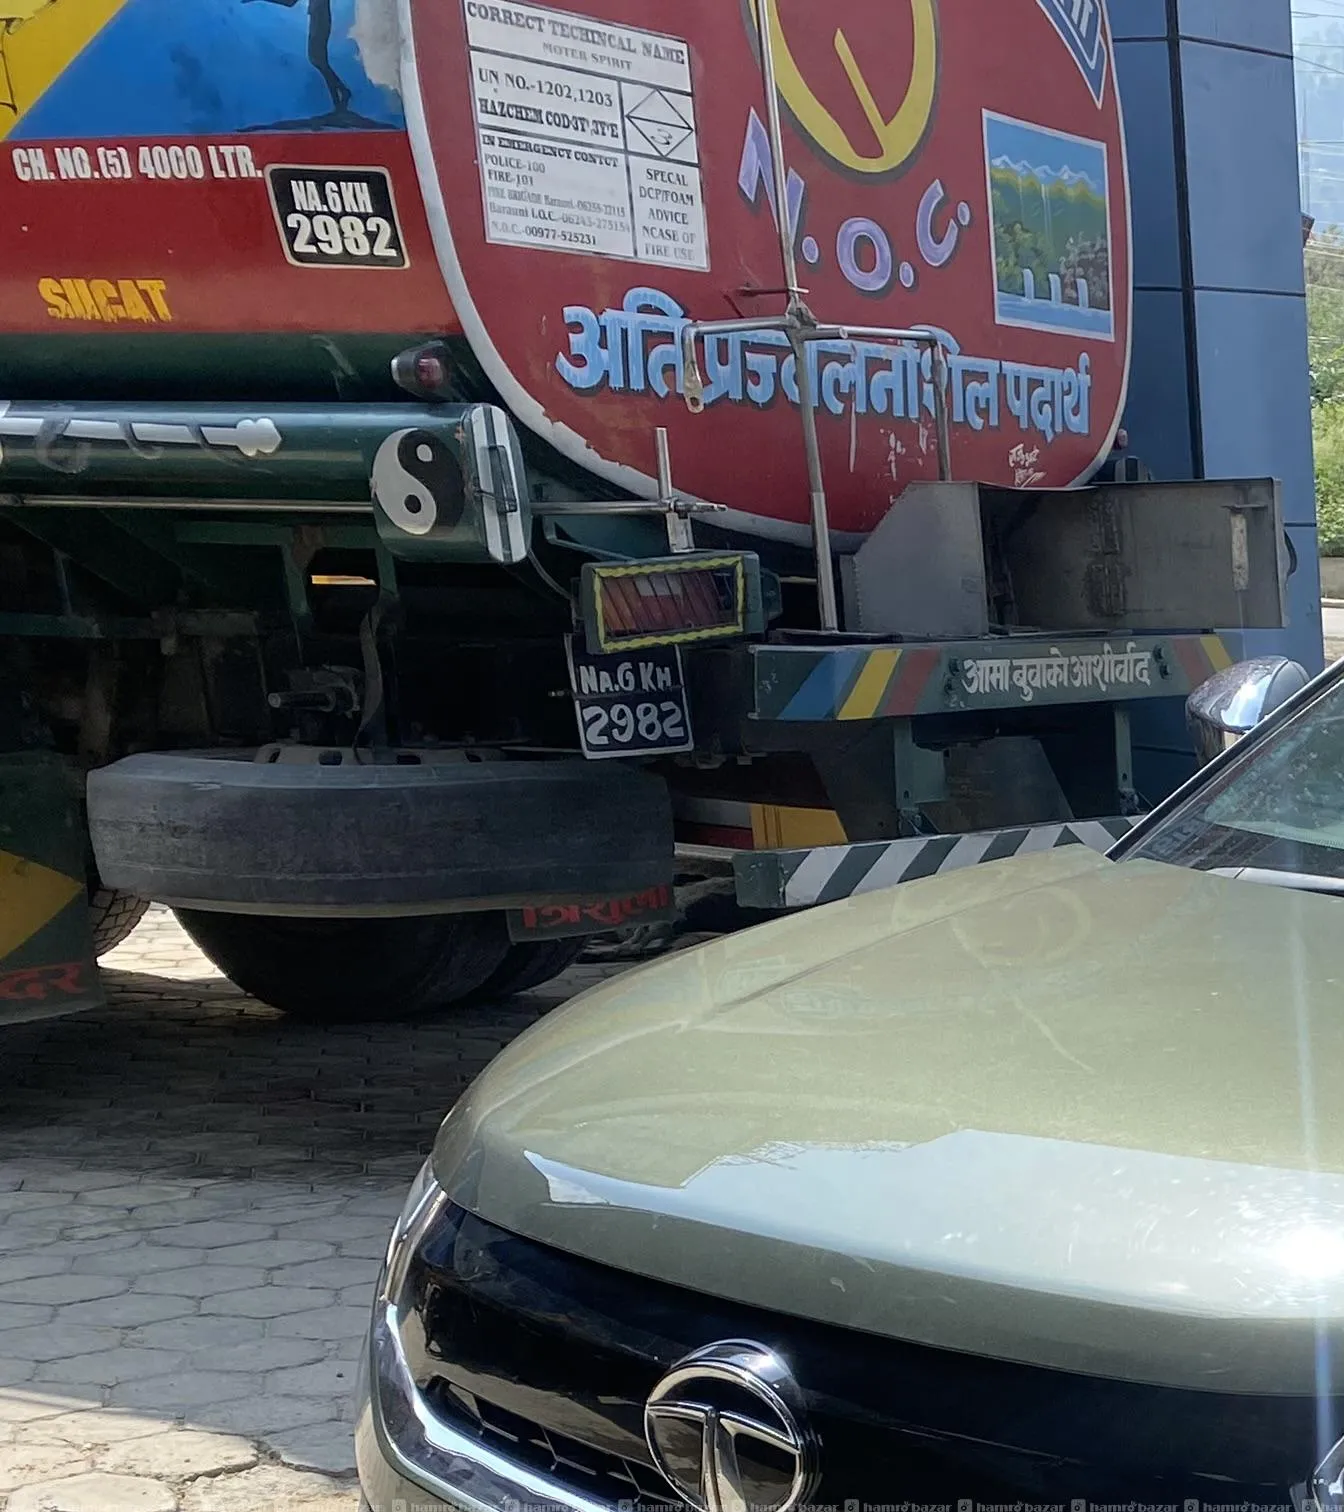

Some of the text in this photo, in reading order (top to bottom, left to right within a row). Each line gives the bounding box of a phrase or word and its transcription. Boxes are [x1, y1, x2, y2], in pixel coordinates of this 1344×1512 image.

[467, 1, 545, 33] CORRECT
[641, 42, 685, 66] NAME
[478, 67, 500, 85] UN
[12, 147, 56, 182] CH.
[137, 145, 205, 180] 4000
[207, 144, 263, 179] LTR.
[286, 213, 397, 257] 2982
[648, 208, 689, 226] ADVICE
[582, 701, 685, 745] 2982
